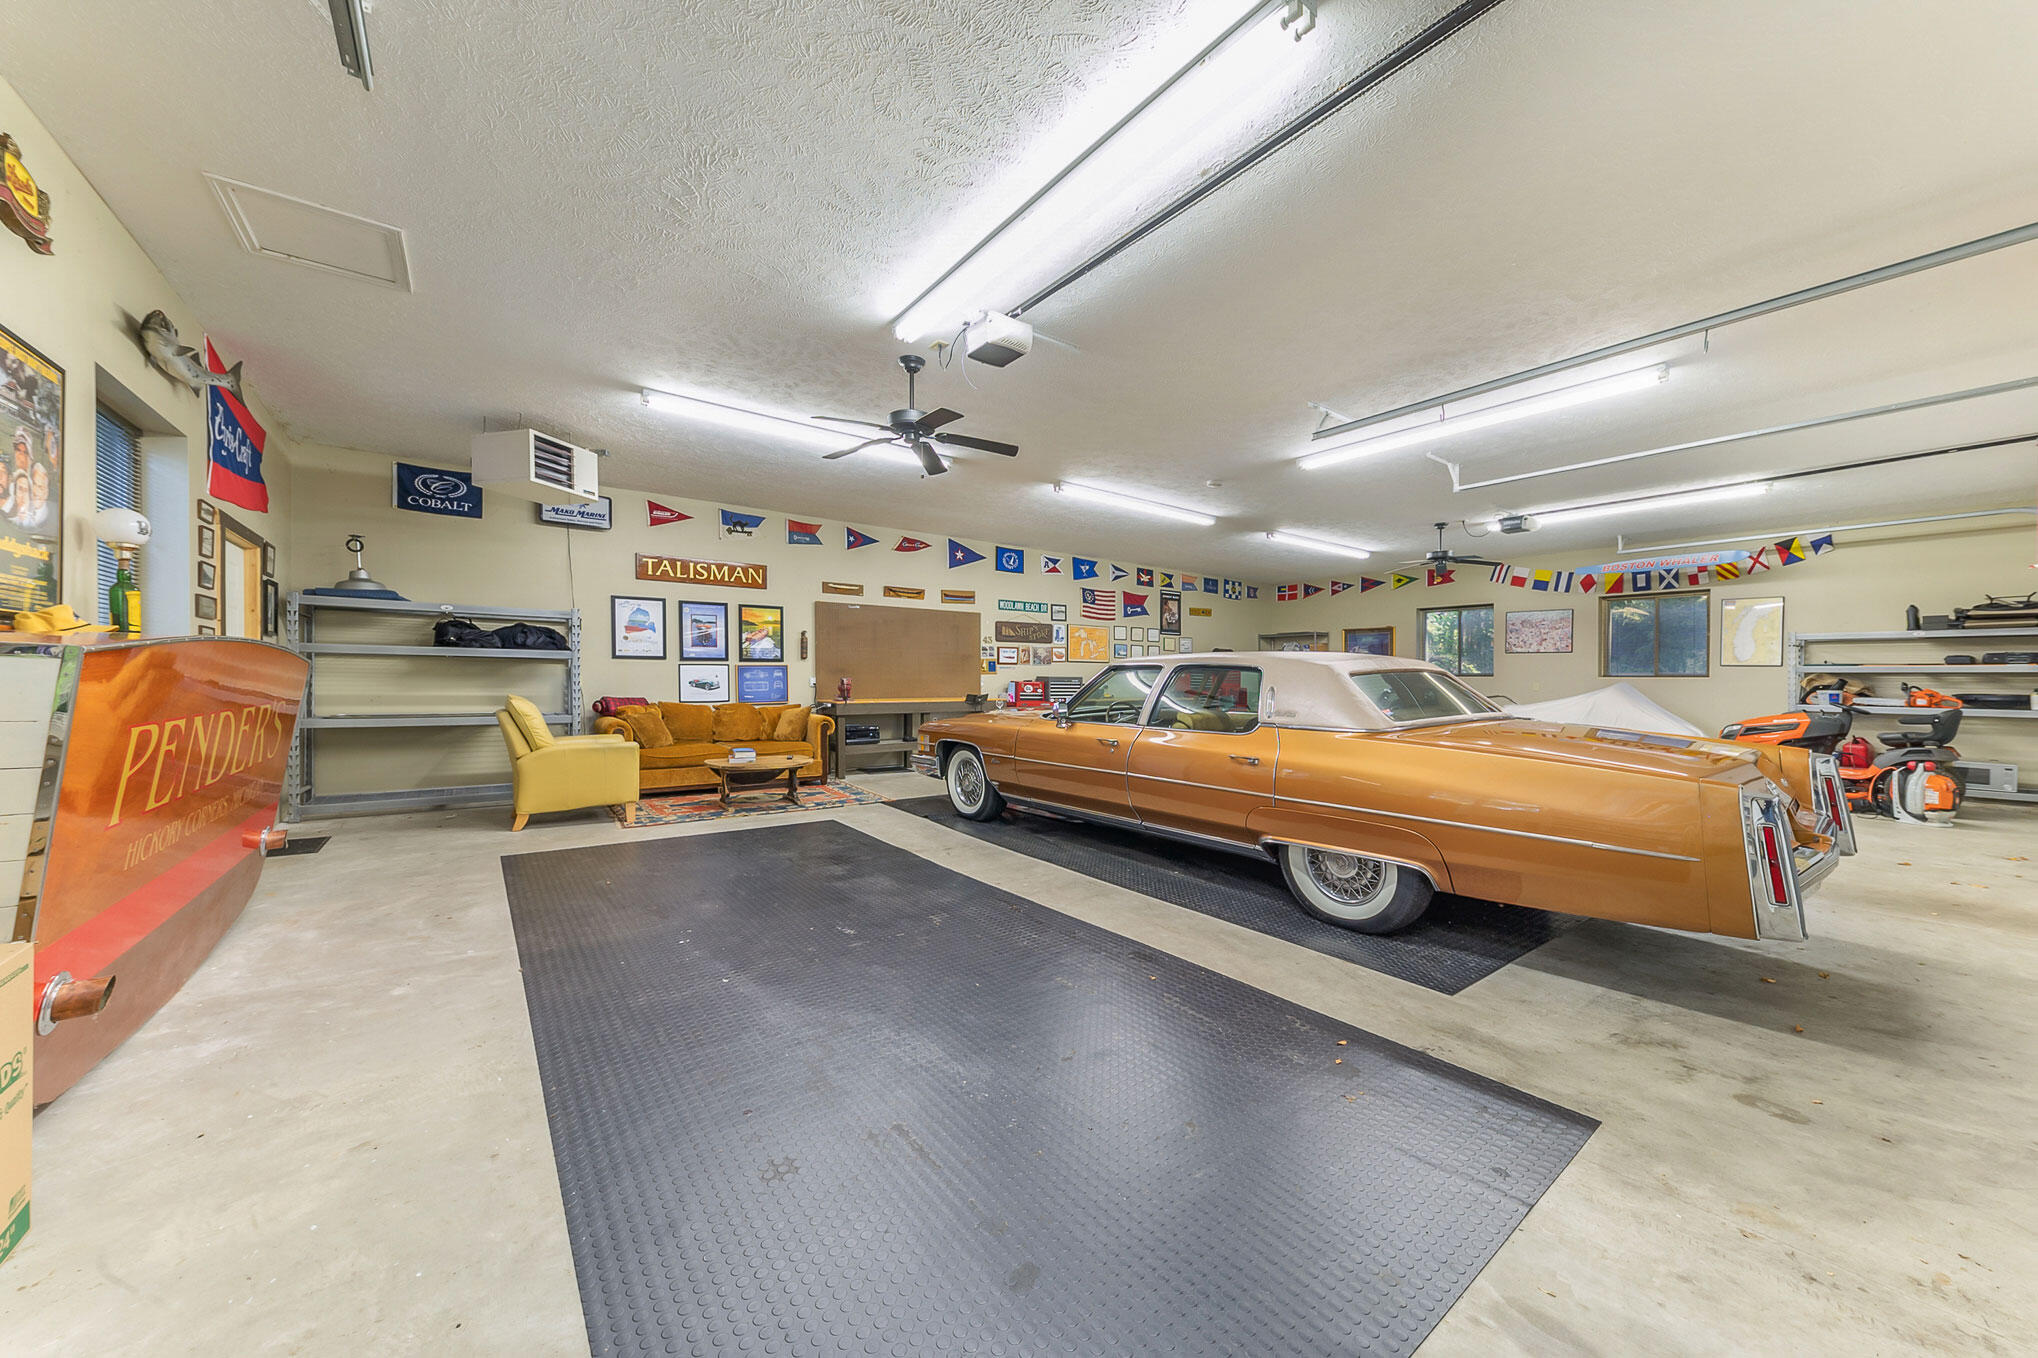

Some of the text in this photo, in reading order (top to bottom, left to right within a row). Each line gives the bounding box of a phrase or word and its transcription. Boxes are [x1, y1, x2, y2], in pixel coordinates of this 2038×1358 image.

[407, 495, 473, 512] COBALT
[642, 558, 763, 585] TALISMAN
[1602, 553, 1720, 572] BOSTON WHALER
[1025, 603, 1040, 612] BEACH
[106, 701, 286, 829] PENDER'S
[123, 819, 186, 872] HICKORY
